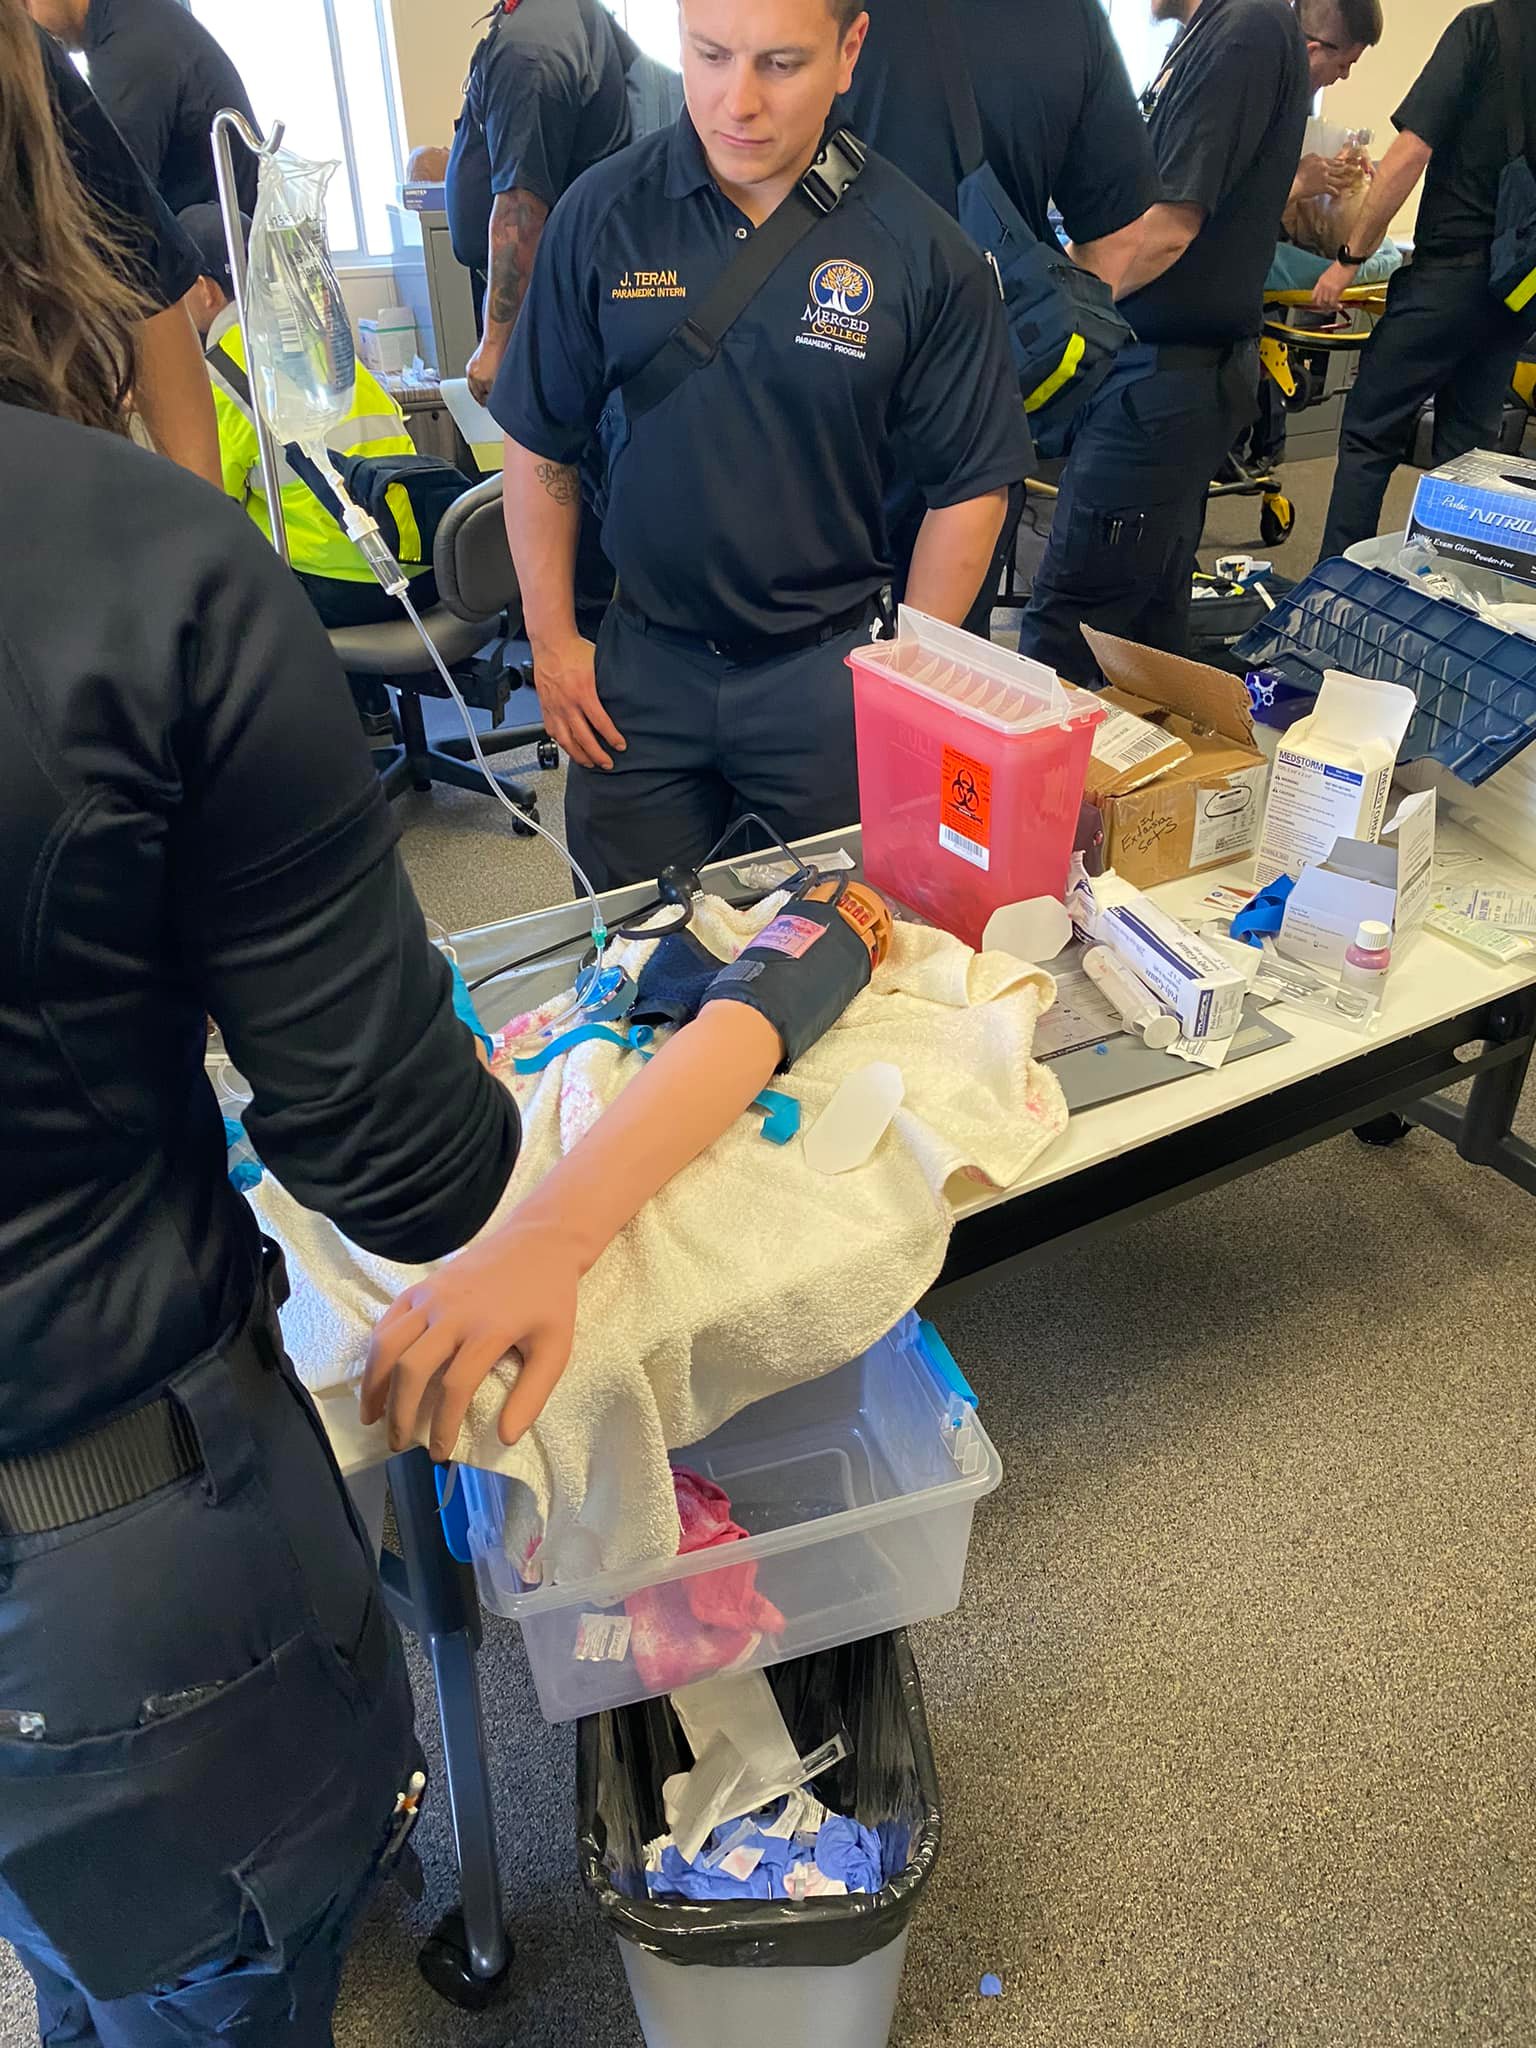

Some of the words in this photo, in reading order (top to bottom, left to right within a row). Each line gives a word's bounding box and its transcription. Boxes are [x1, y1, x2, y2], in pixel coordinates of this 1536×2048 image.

[620, 271, 632, 287] J.
[634, 270, 677, 287] TERAN
[611, 288, 656, 299] PARAMEDIC
[657, 286, 686, 298] INTERN
[800, 303, 870, 333] MERCED
[812, 320, 868, 344] COLLEGE
[794, 335, 833, 351] PARAMEDIC
[833, 344, 867, 360] PROGRAM
[1433, 538, 1454, 550] Exam
[1454, 542, 1478, 556] Gloves
[1474, 553, 1515, 569] Powder-Free
[1279, 750, 1324, 772] MEDSTORM
